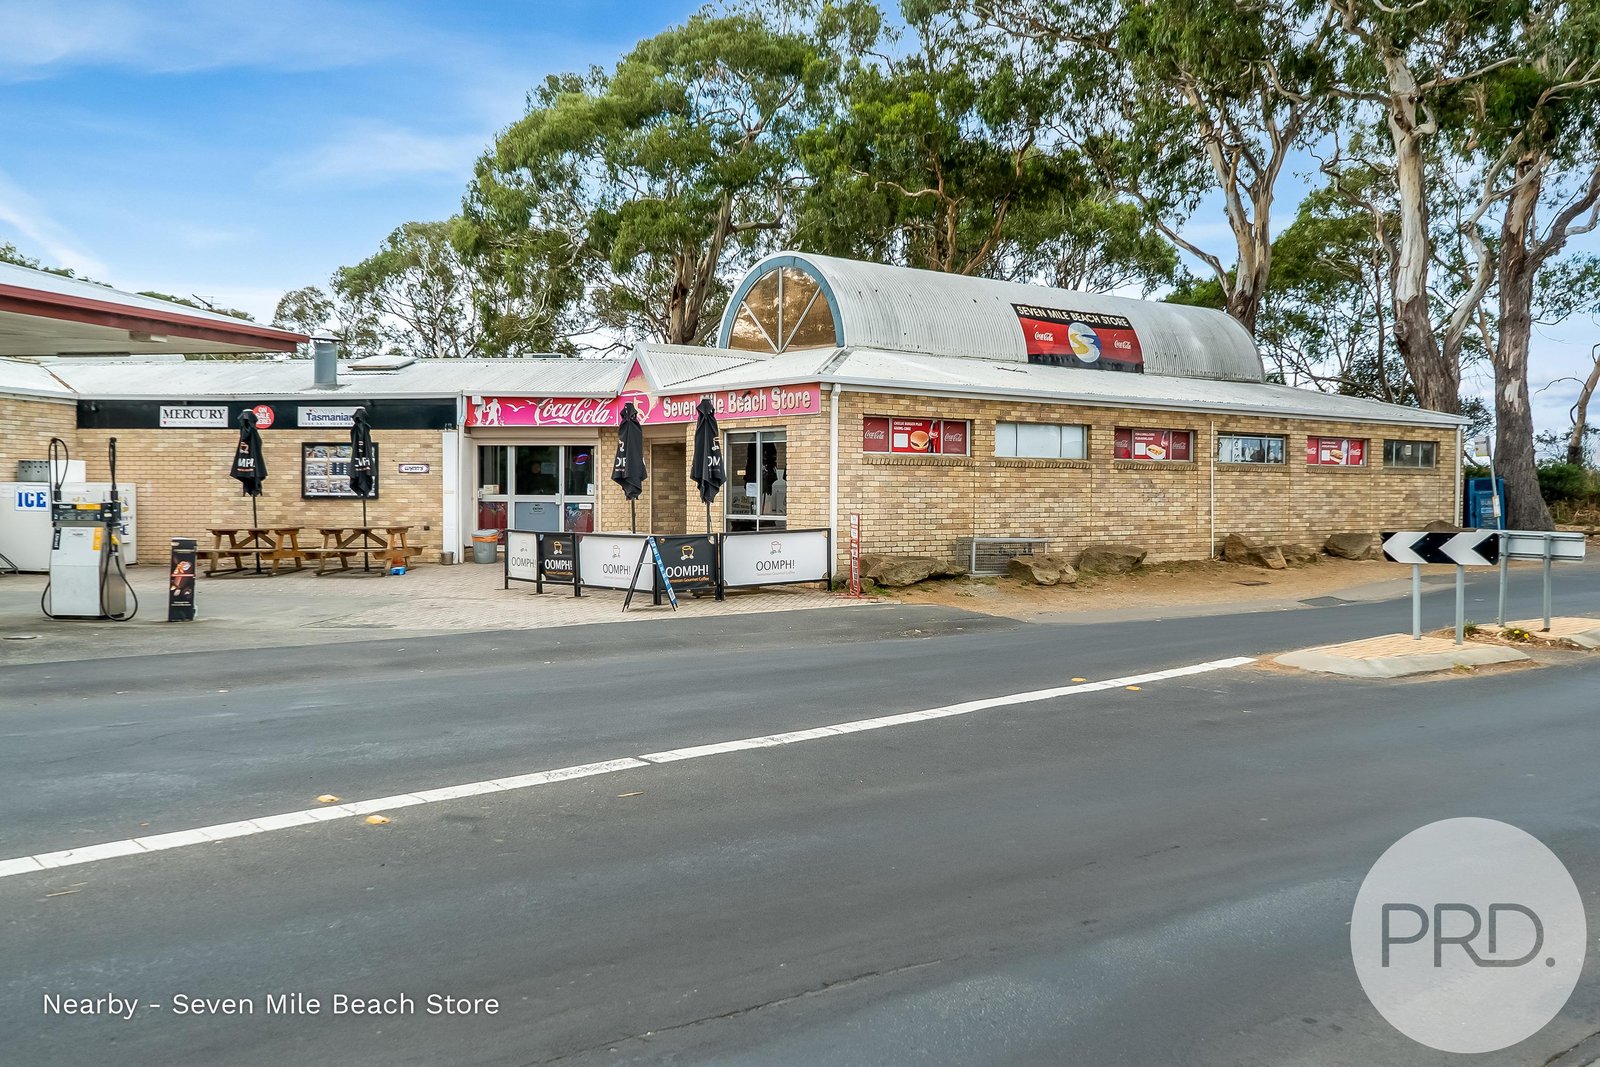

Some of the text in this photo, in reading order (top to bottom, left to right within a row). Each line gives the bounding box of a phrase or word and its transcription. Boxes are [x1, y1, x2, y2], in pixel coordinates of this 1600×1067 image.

[1016, 305, 1129, 327] SEVEN MILE BEACH STORE
[663, 396, 697, 418] Seven
[728, 389, 767, 413] Beach
[771, 386, 812, 410] Store
[163, 409, 226, 419] MERCURY
[534, 398, 613, 426] Coca-Cola
[17, 491, 47, 508] ICE
[544, 558, 573, 570] OOMPH!
[602, 563, 631, 576] OOMPH!
[665, 564, 709, 578] OOMPH!
[755, 559, 795, 571] OOMPH!
